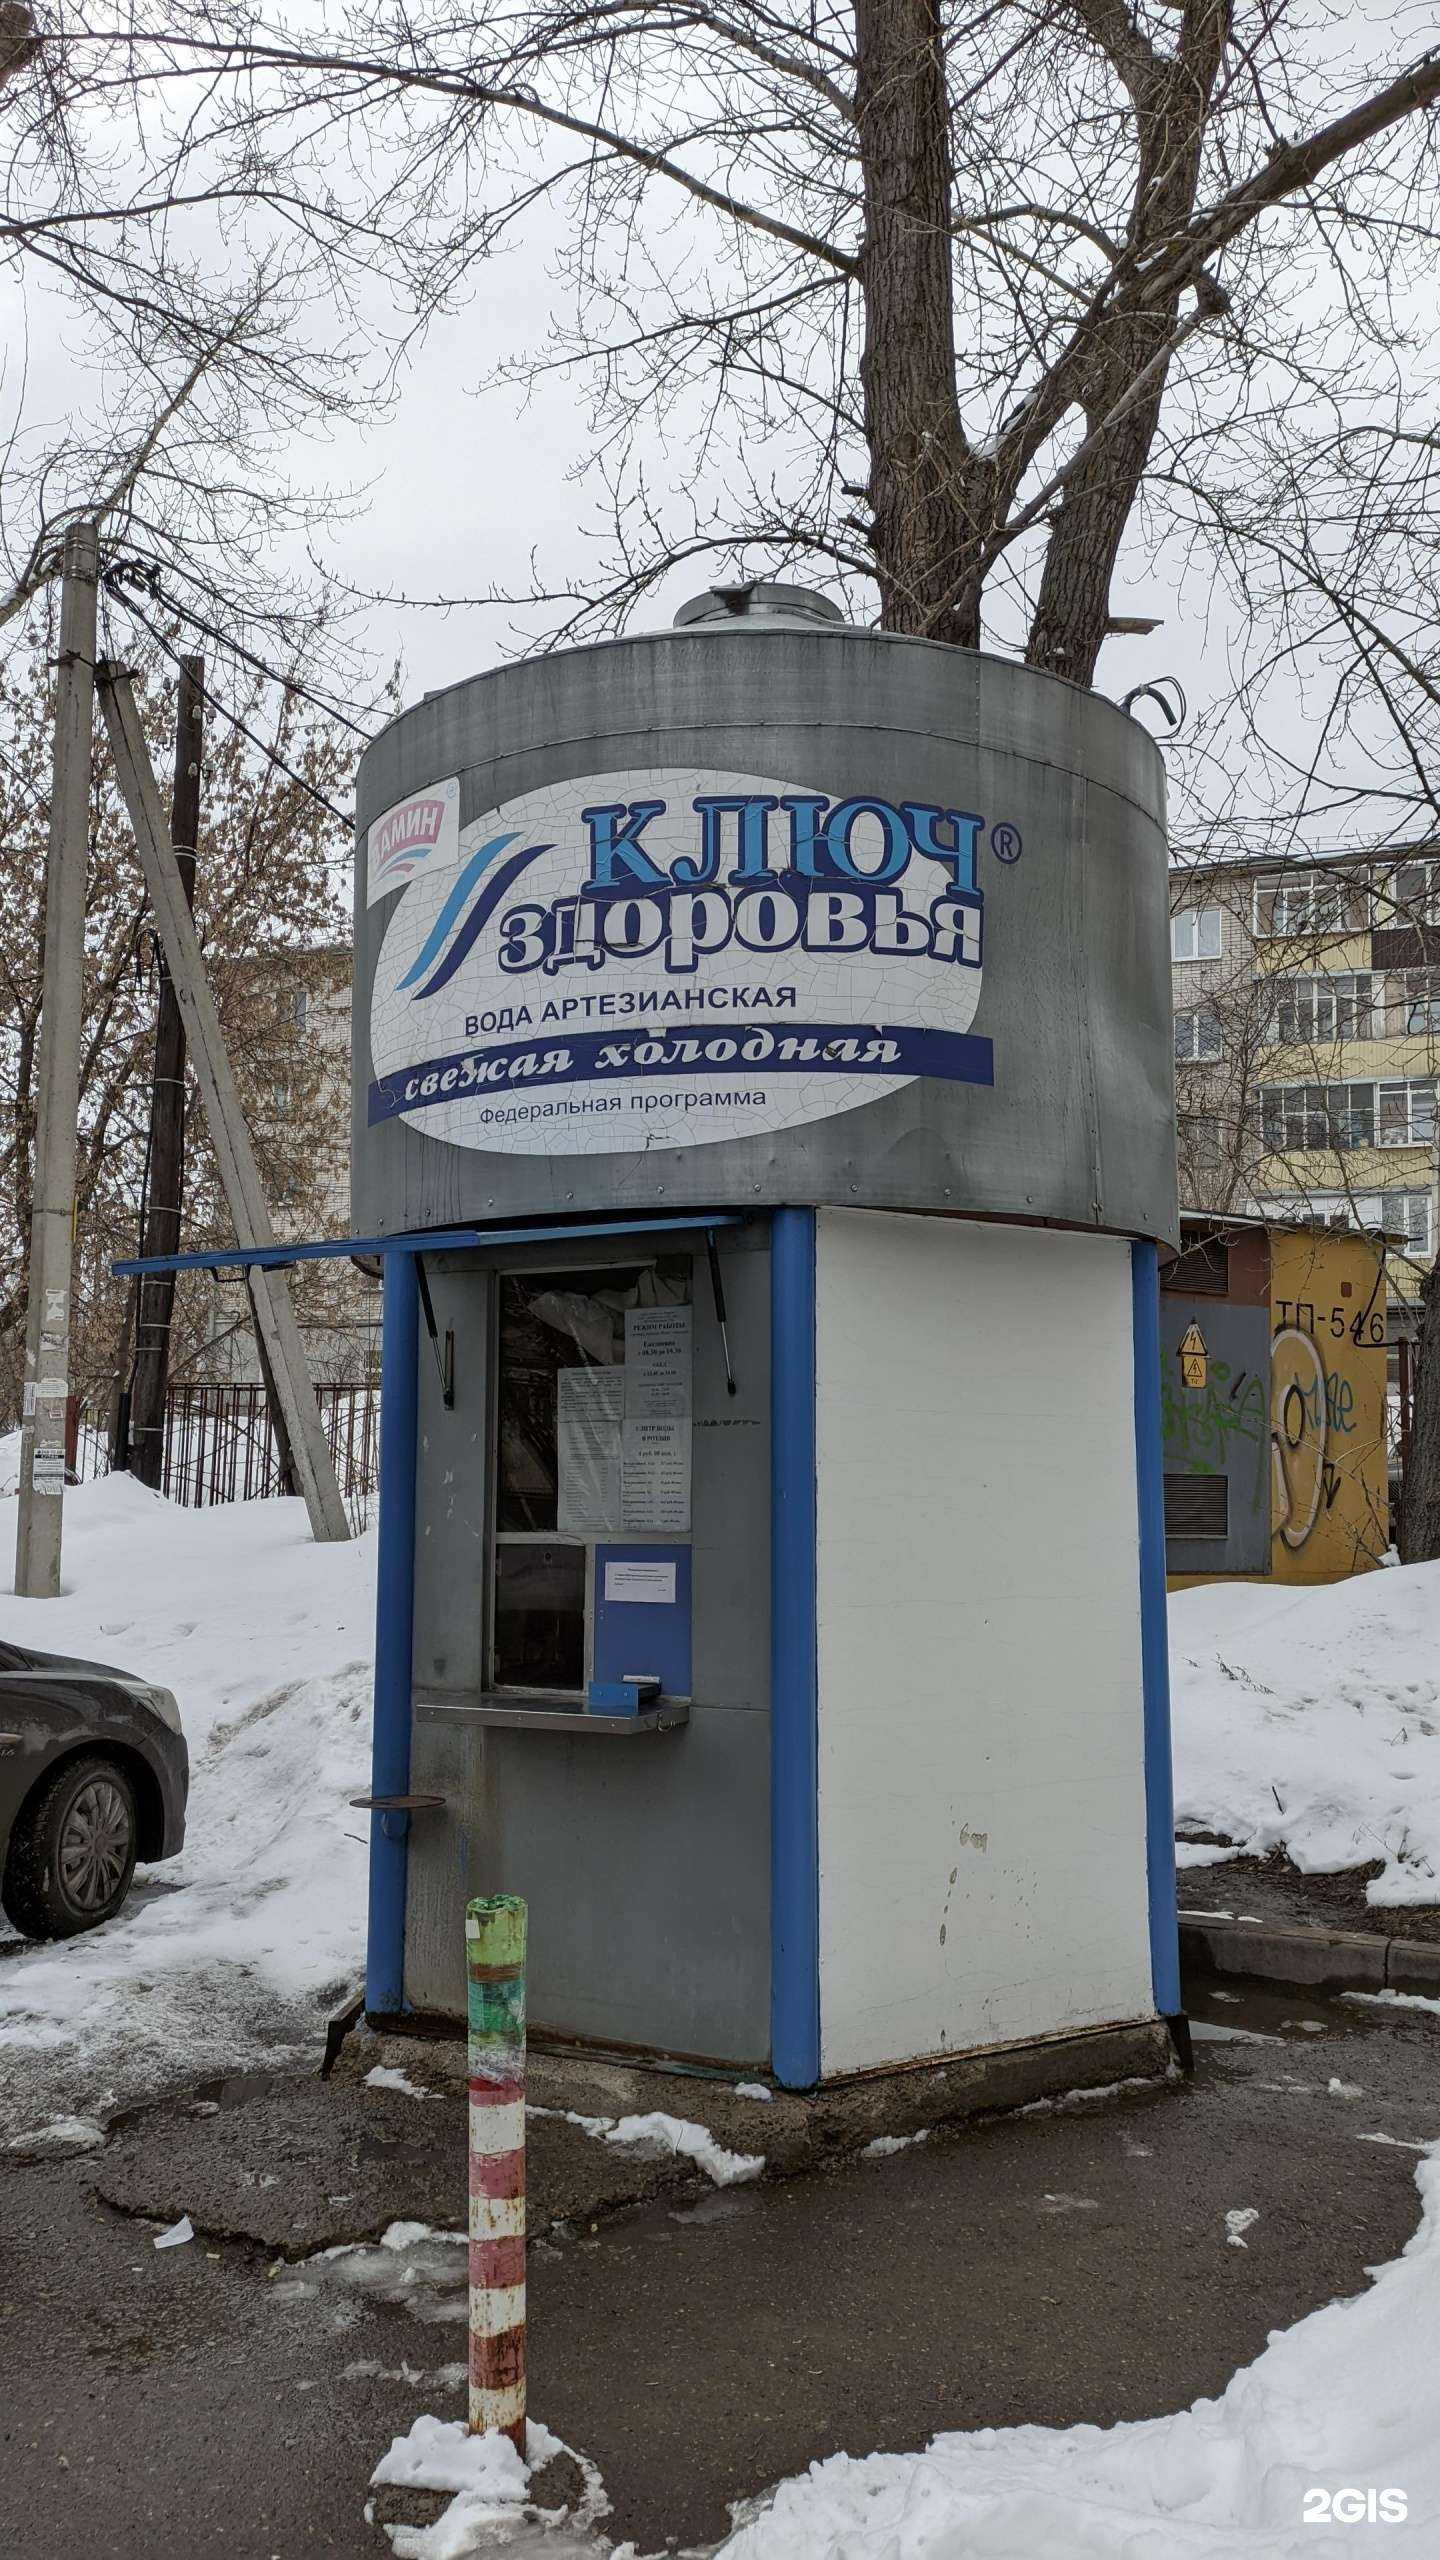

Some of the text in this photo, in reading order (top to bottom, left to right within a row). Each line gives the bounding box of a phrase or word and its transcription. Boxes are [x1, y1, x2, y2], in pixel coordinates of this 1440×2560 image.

[581, 795, 985, 900] КЛЮЧ
[465, 986, 797, 1036] ВОДА АРТЕЗИАНСКАЯ
[403, 1026, 902, 1101] свежая холодная
[480, 1091, 767, 1125] Федеральная программа
